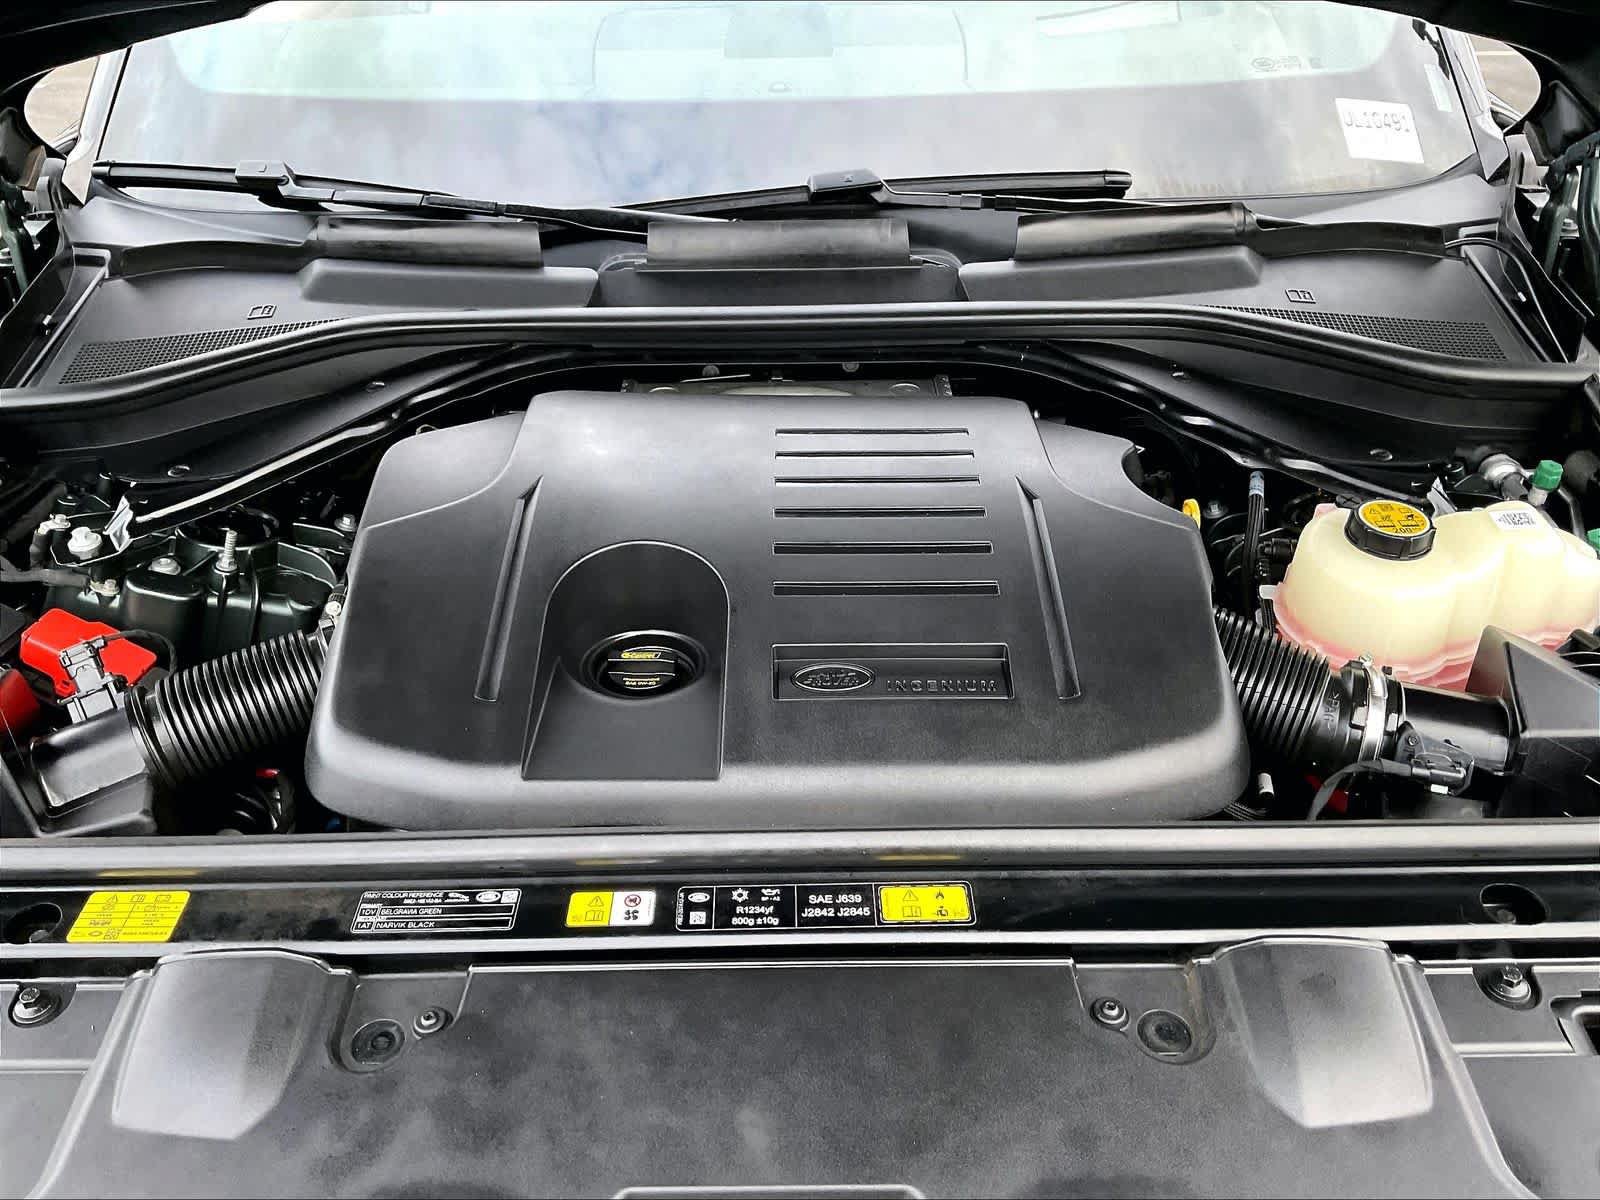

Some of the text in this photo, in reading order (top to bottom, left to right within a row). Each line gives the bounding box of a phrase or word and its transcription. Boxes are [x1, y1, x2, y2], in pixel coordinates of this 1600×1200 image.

[887, 679, 997, 692] INGENIUM
[808, 893, 862, 904] SAE J639
[418, 907, 443, 915] GREEN
[736, 905, 775, 914] R1234yf
[801, 907, 836, 918] J2842
[376, 921, 407, 929] NARVIK
